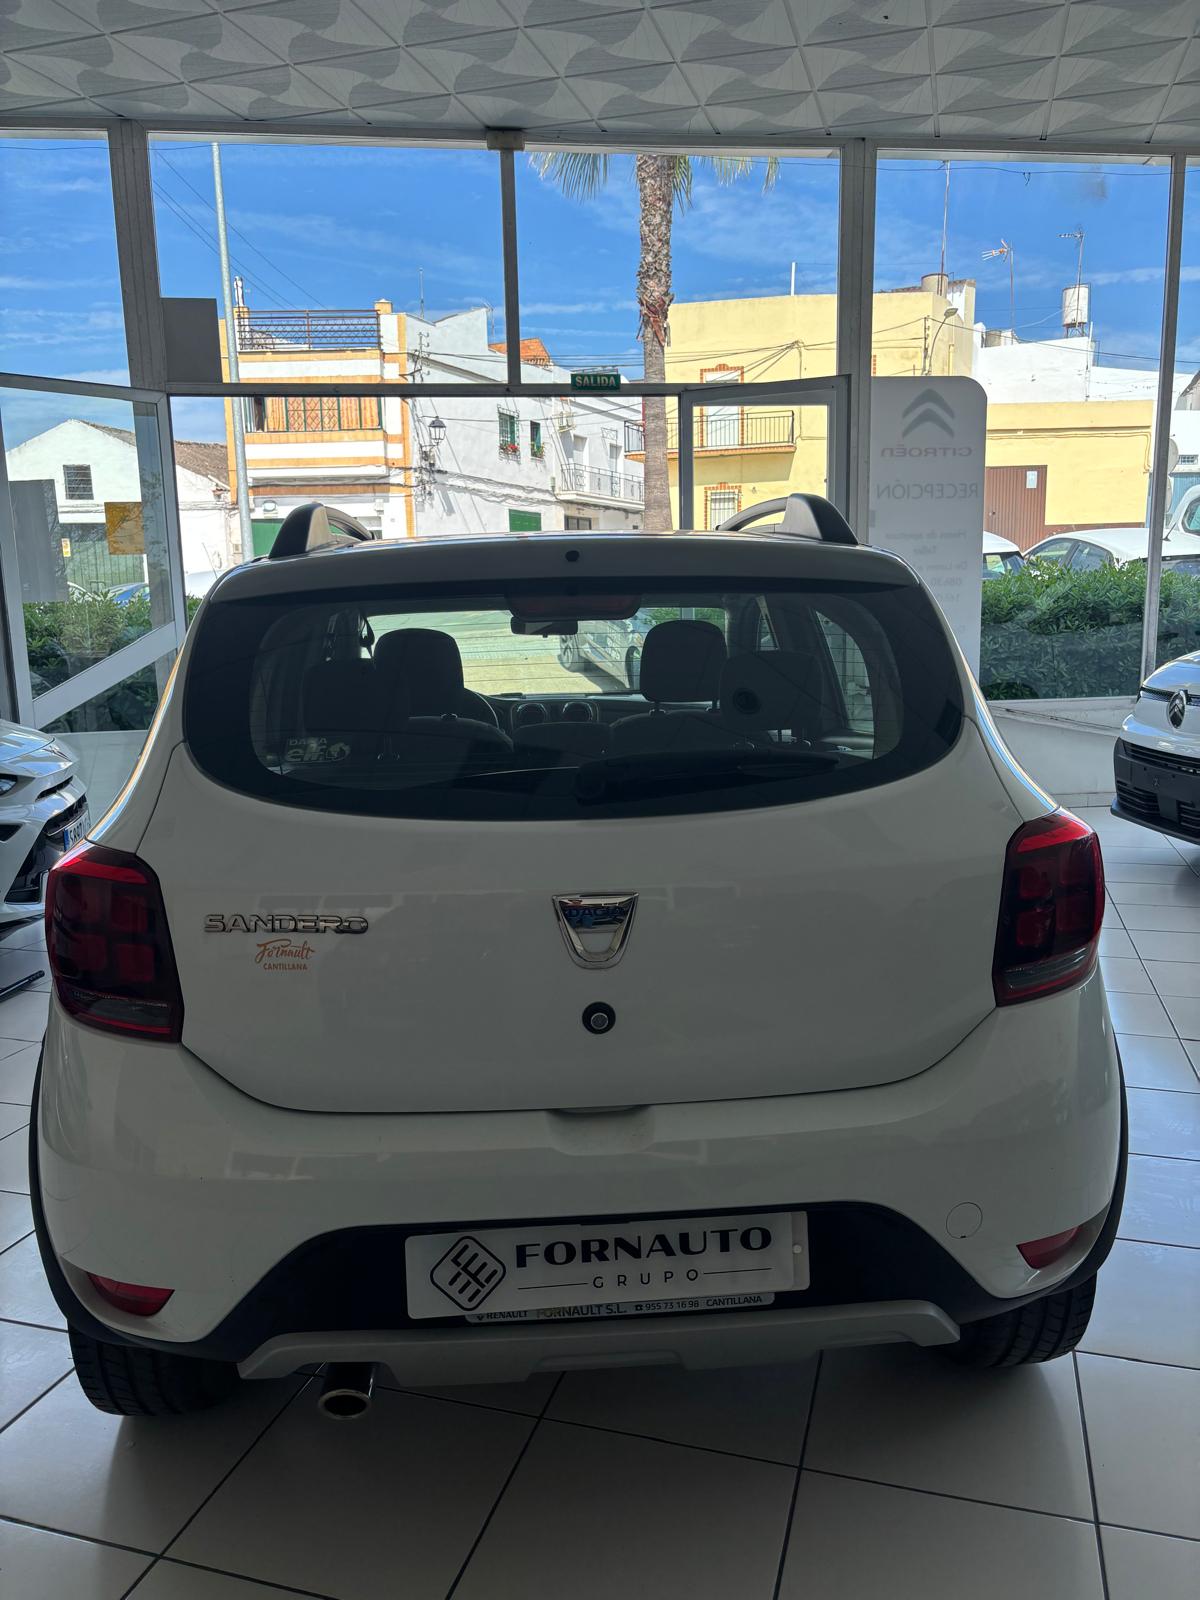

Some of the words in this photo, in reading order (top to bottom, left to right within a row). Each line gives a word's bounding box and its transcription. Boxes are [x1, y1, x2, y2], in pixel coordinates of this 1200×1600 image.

[575, 375, 617, 387] SALIDA
[203, 914, 369, 935] SANDERO
[254, 938, 316, 965] Fornault
[263, 963, 308, 971] CANTILLANA
[515, 1226, 772, 1268] FORNAUTO
[592, 1268, 699, 1289] GRUPO
[486, 1310, 528, 1319] RENAULT
[535, 1304, 603, 1318] FORNAULT
[605, 1304, 627, 1315] S.L.
[644, 1303, 662, 1311] 955
[688, 1301, 700, 1309] 98
[706, 1296, 762, 1307] CANTILLANA
